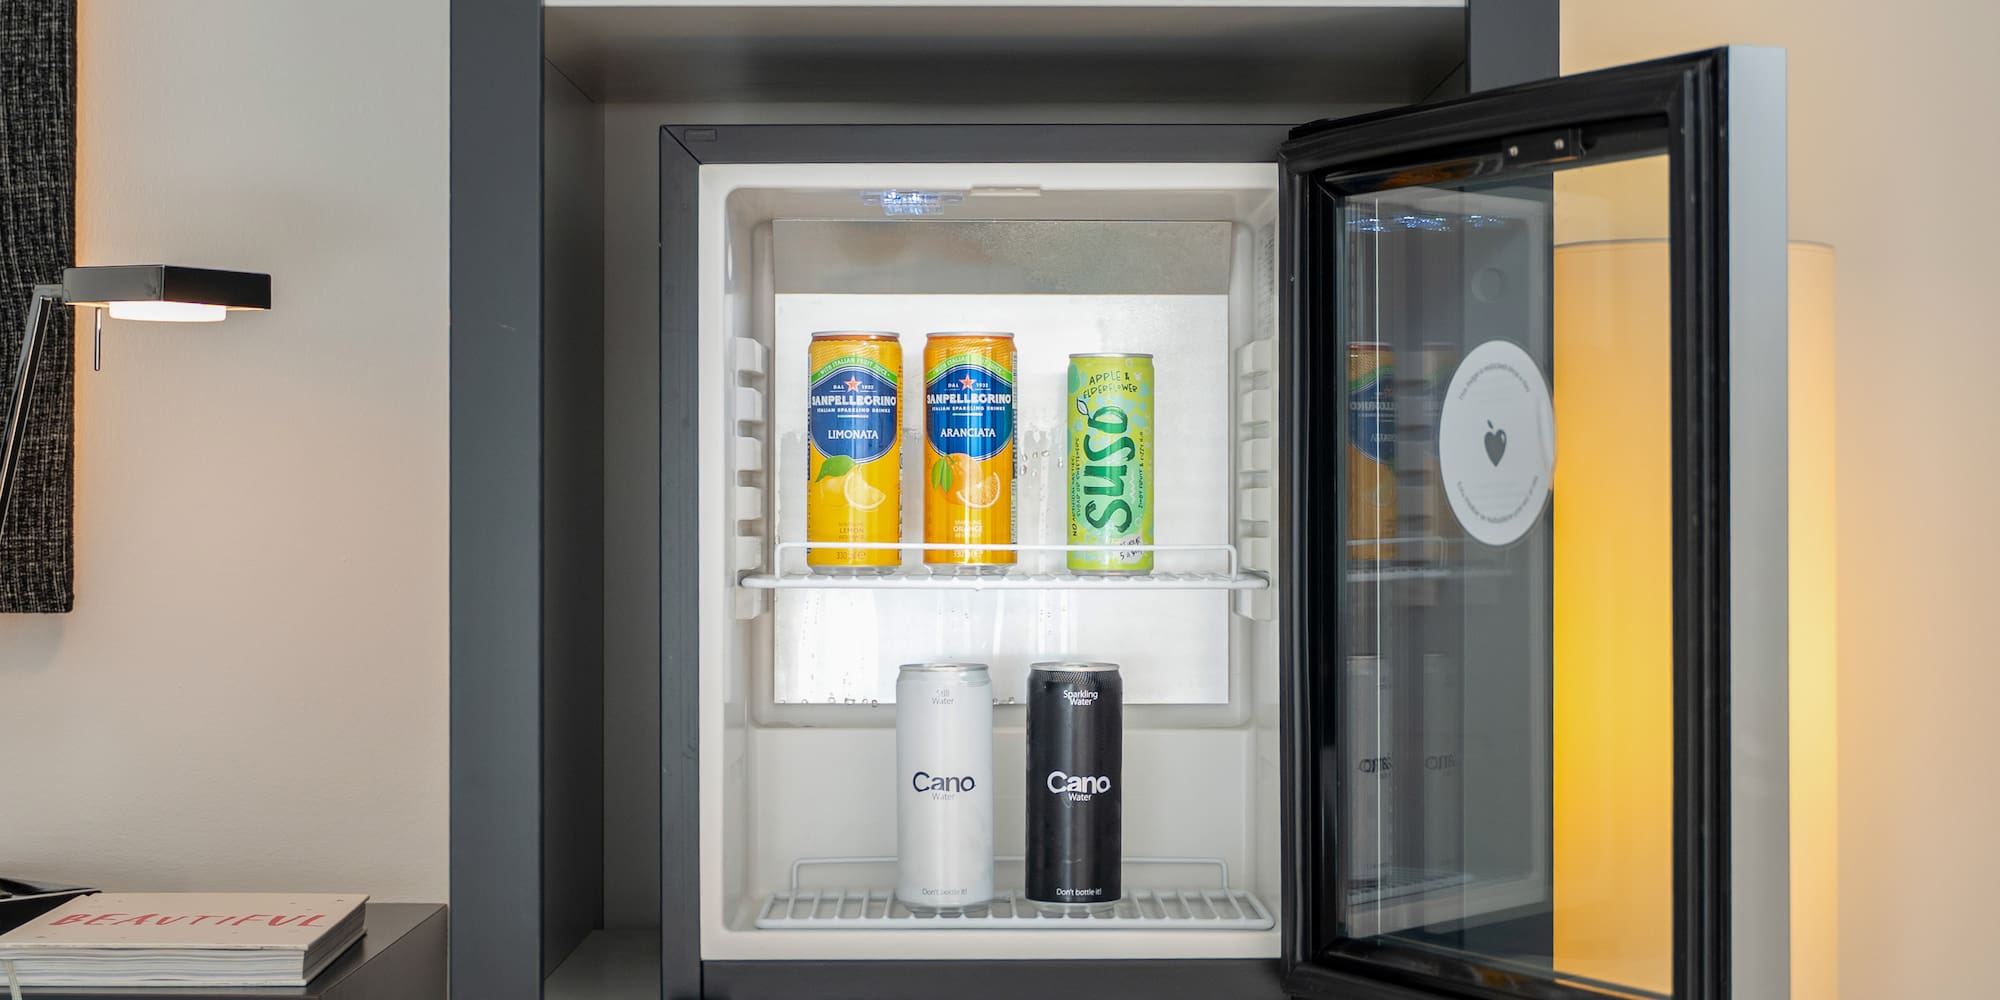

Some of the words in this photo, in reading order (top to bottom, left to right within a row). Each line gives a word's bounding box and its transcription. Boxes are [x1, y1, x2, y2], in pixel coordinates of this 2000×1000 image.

[1089, 370, 1121, 385] APPLE
[811, 395, 897, 406] SANPELLEGRINO
[927, 393, 1012, 404] SANPELLEGRINO
[828, 430, 879, 440] LIMONATA
[940, 428, 996, 438] ARANCIATA
[1072, 523, 1078, 537] NO
[1063, 690, 1099, 700] Sparkling
[931, 697, 954, 705] Water
[1069, 697, 1093, 706] Water
[913, 771, 976, 792] Cano
[1047, 770, 1111, 794] Cano
[931, 793, 955, 801] Water
[1068, 793, 1092, 801] Water
[1056, 888, 1075, 896] Don't
[1075, 888, 1094, 896] bottle
[49, 913, 327, 928] BEAUTIFUL
